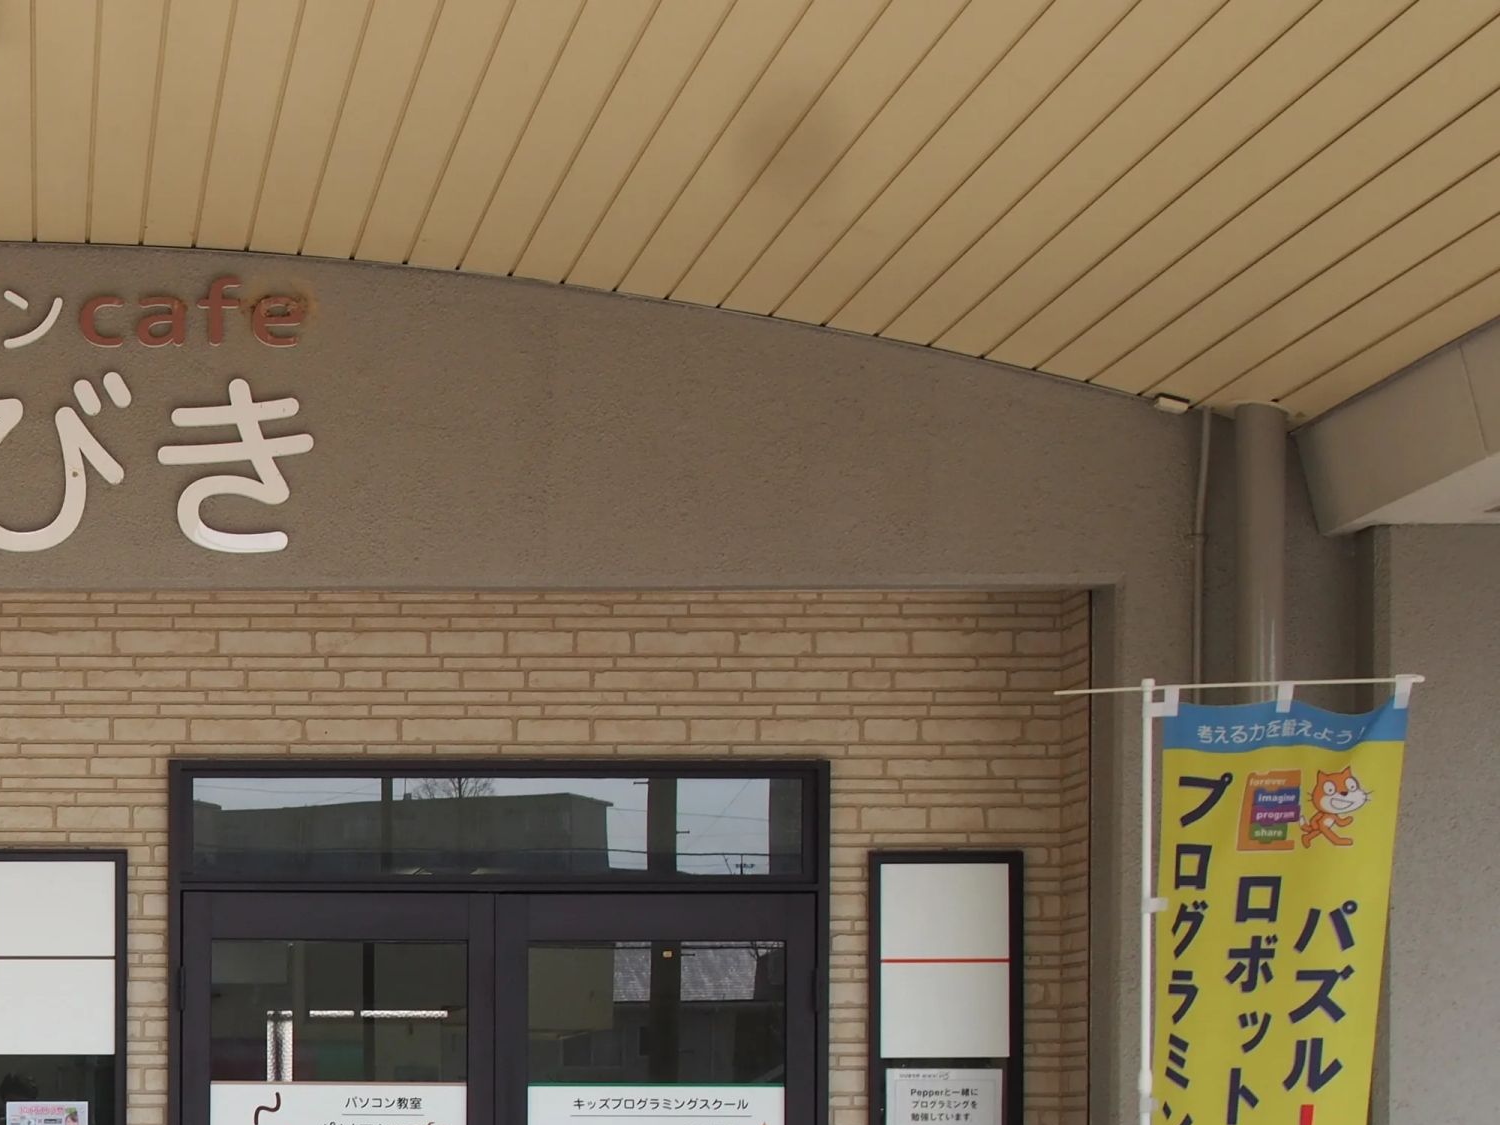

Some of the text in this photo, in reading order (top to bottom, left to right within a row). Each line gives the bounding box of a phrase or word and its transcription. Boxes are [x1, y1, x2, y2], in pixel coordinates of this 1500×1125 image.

[1258, 793, 1296, 804] imagine
[1255, 810, 1295, 821] program
[1254, 828, 1284, 838] share
[344, 1096, 422, 1111] パソコン教室
[572, 1097, 749, 1112] キッズプログラミングスクール
[911, 1100, 978, 1109] プログラミングを
